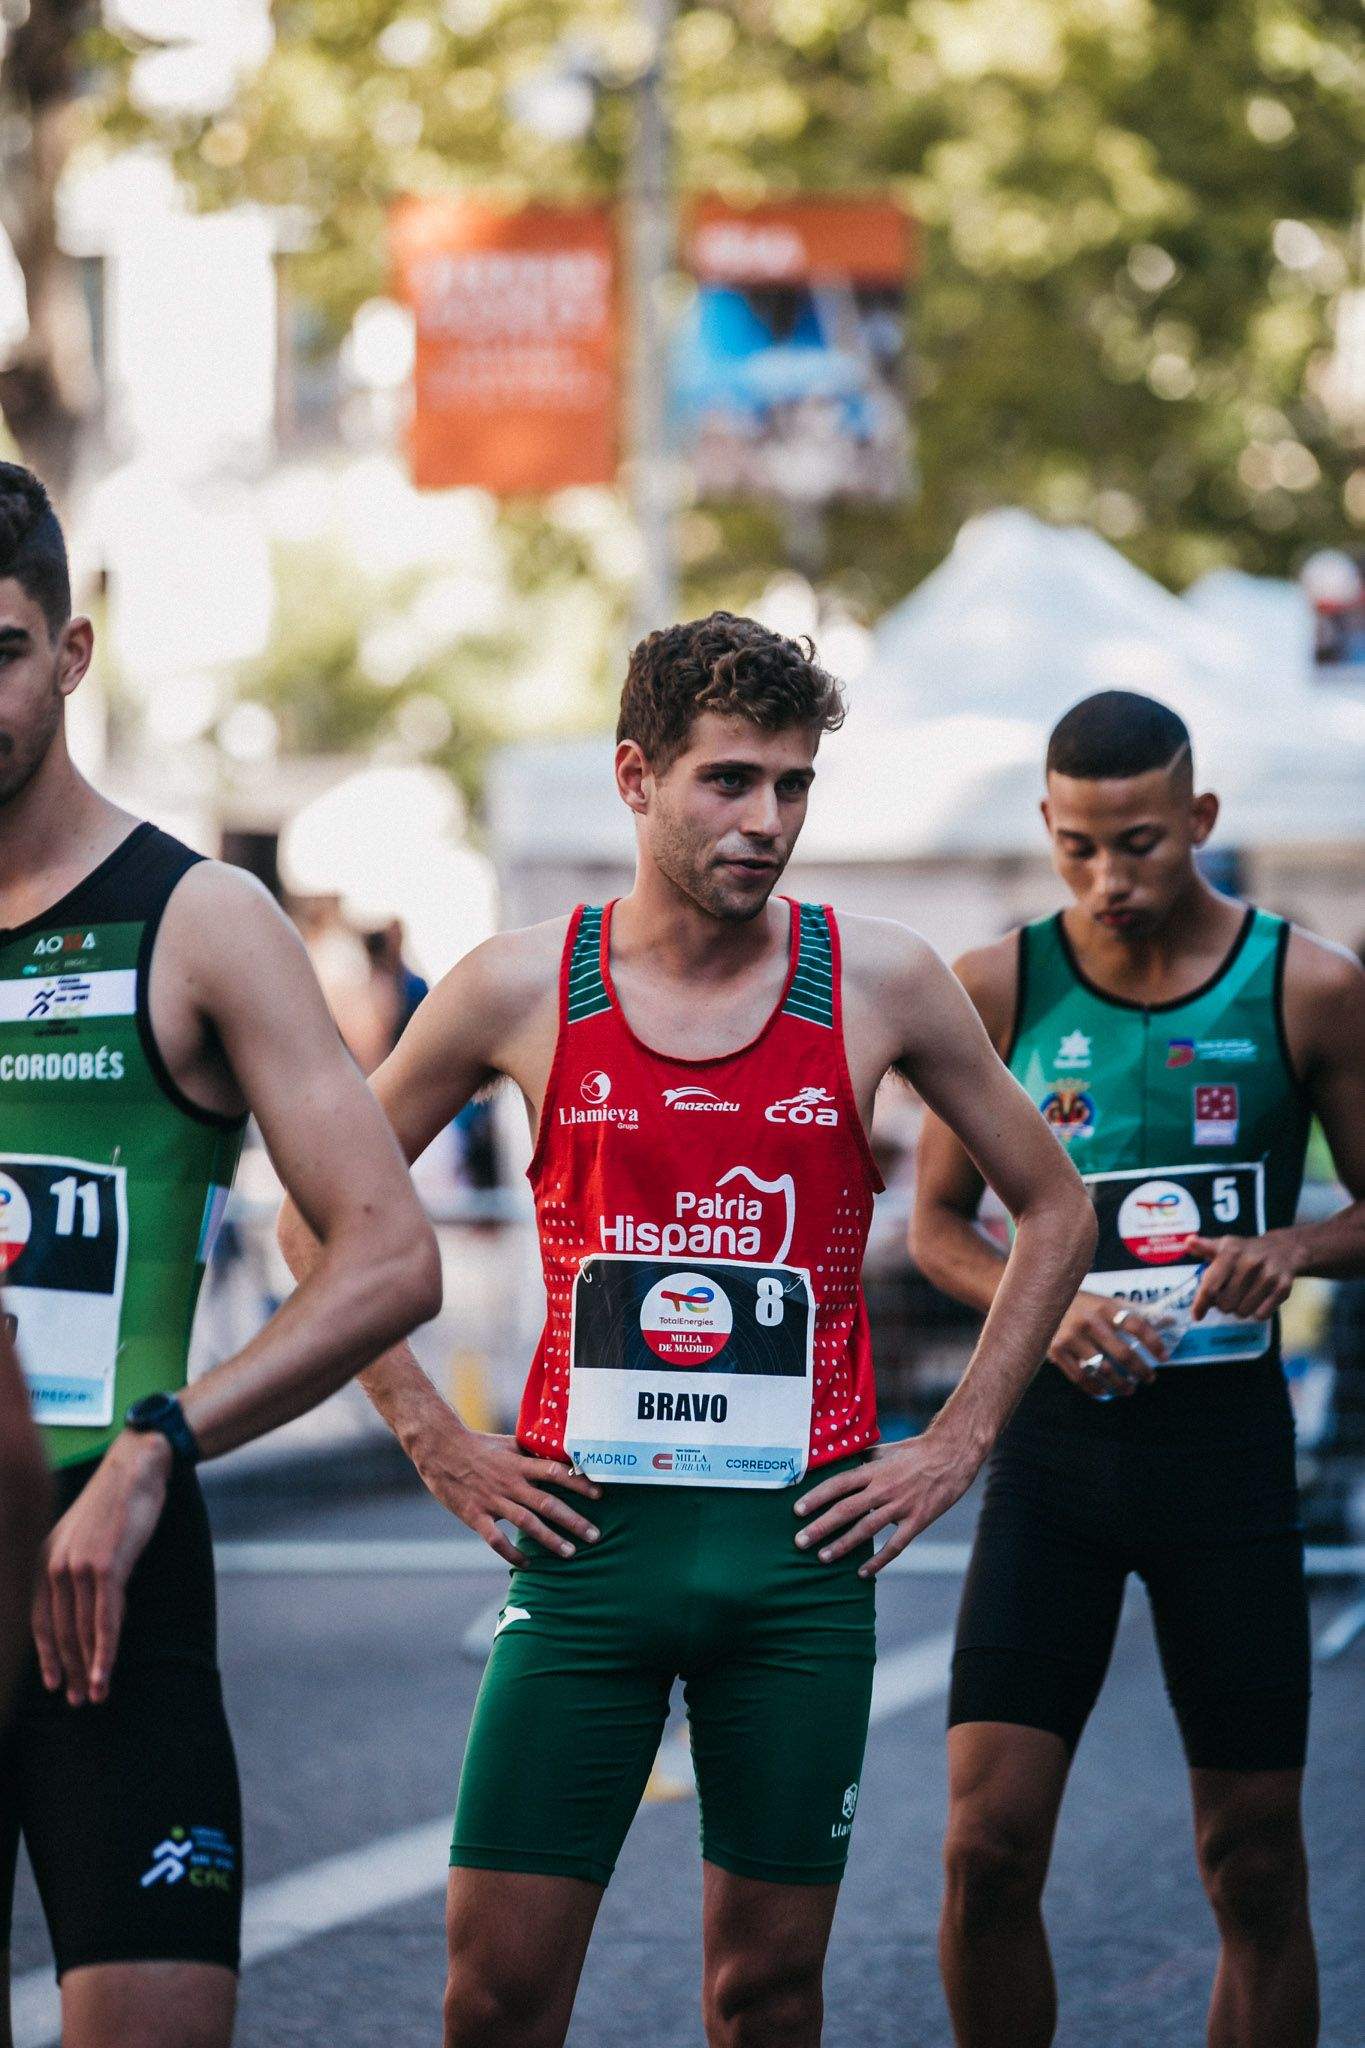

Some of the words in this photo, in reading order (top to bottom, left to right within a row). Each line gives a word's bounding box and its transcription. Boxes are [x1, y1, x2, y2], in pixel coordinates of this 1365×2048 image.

[0, 1046, 124, 1081] CORDOBÉS
[559, 1104, 639, 1125] Llamieva
[617, 1122, 639, 1131] Grupo
[50, 1176, 99, 1237] 11
[676, 1191, 762, 1220] Patria
[1212, 1176, 1240, 1223] 5
[600, 1215, 761, 1257] Hispana
[755, 1277, 785, 1327] 8
[659, 1316, 714, 1327] TotalEnergies
[659, 1343, 673, 1352] DE
[674, 1344, 714, 1354] MADRID
[671, 1333, 702, 1343] MILLA
[637, 1391, 728, 1424] BRAVO
[587, 1453, 638, 1466] MADRID
[676, 1453, 707, 1463] MILLA
